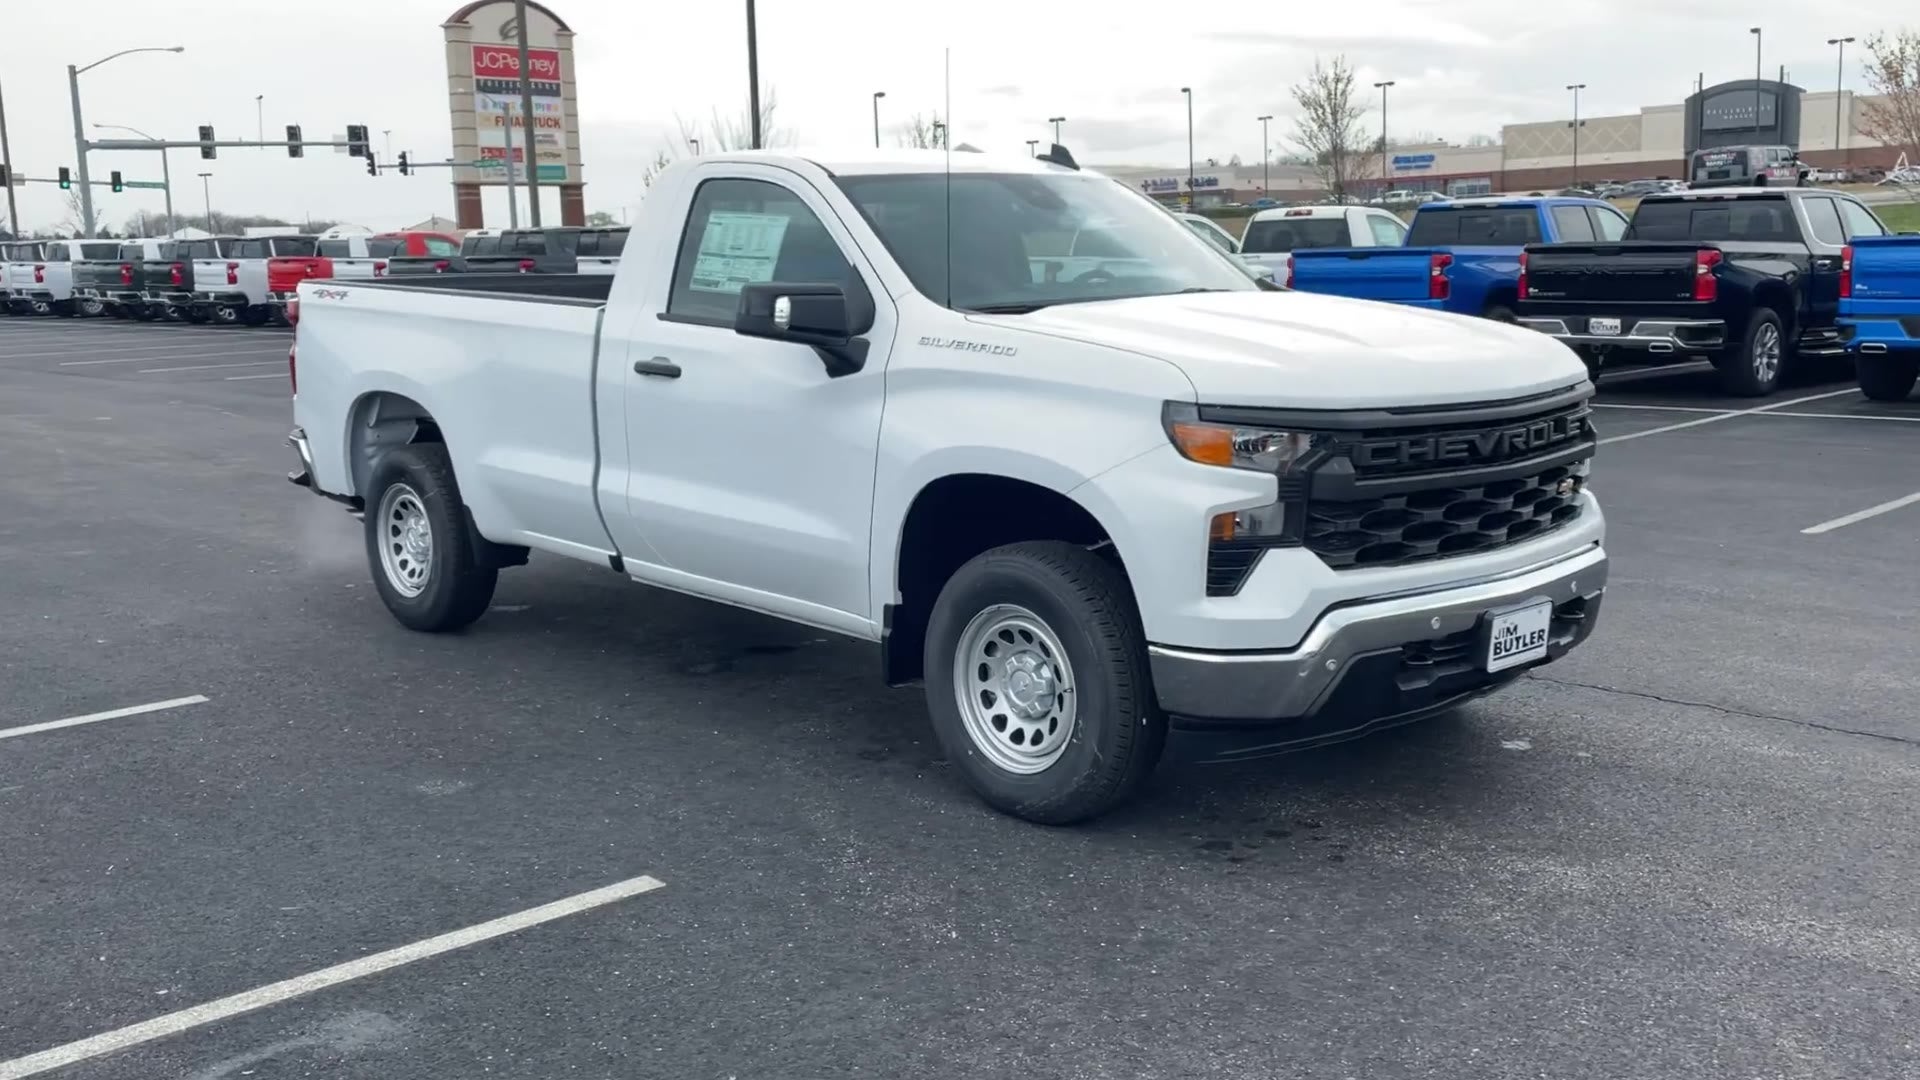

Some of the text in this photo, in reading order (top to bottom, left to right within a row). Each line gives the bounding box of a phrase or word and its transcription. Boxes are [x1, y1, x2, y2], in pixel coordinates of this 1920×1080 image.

[476, 51, 555, 75] JCPeney
[918, 336, 1018, 357] SILVERADO
[1493, 628, 1546, 656] BUTLER
[1494, 624, 1518, 640] JIM
